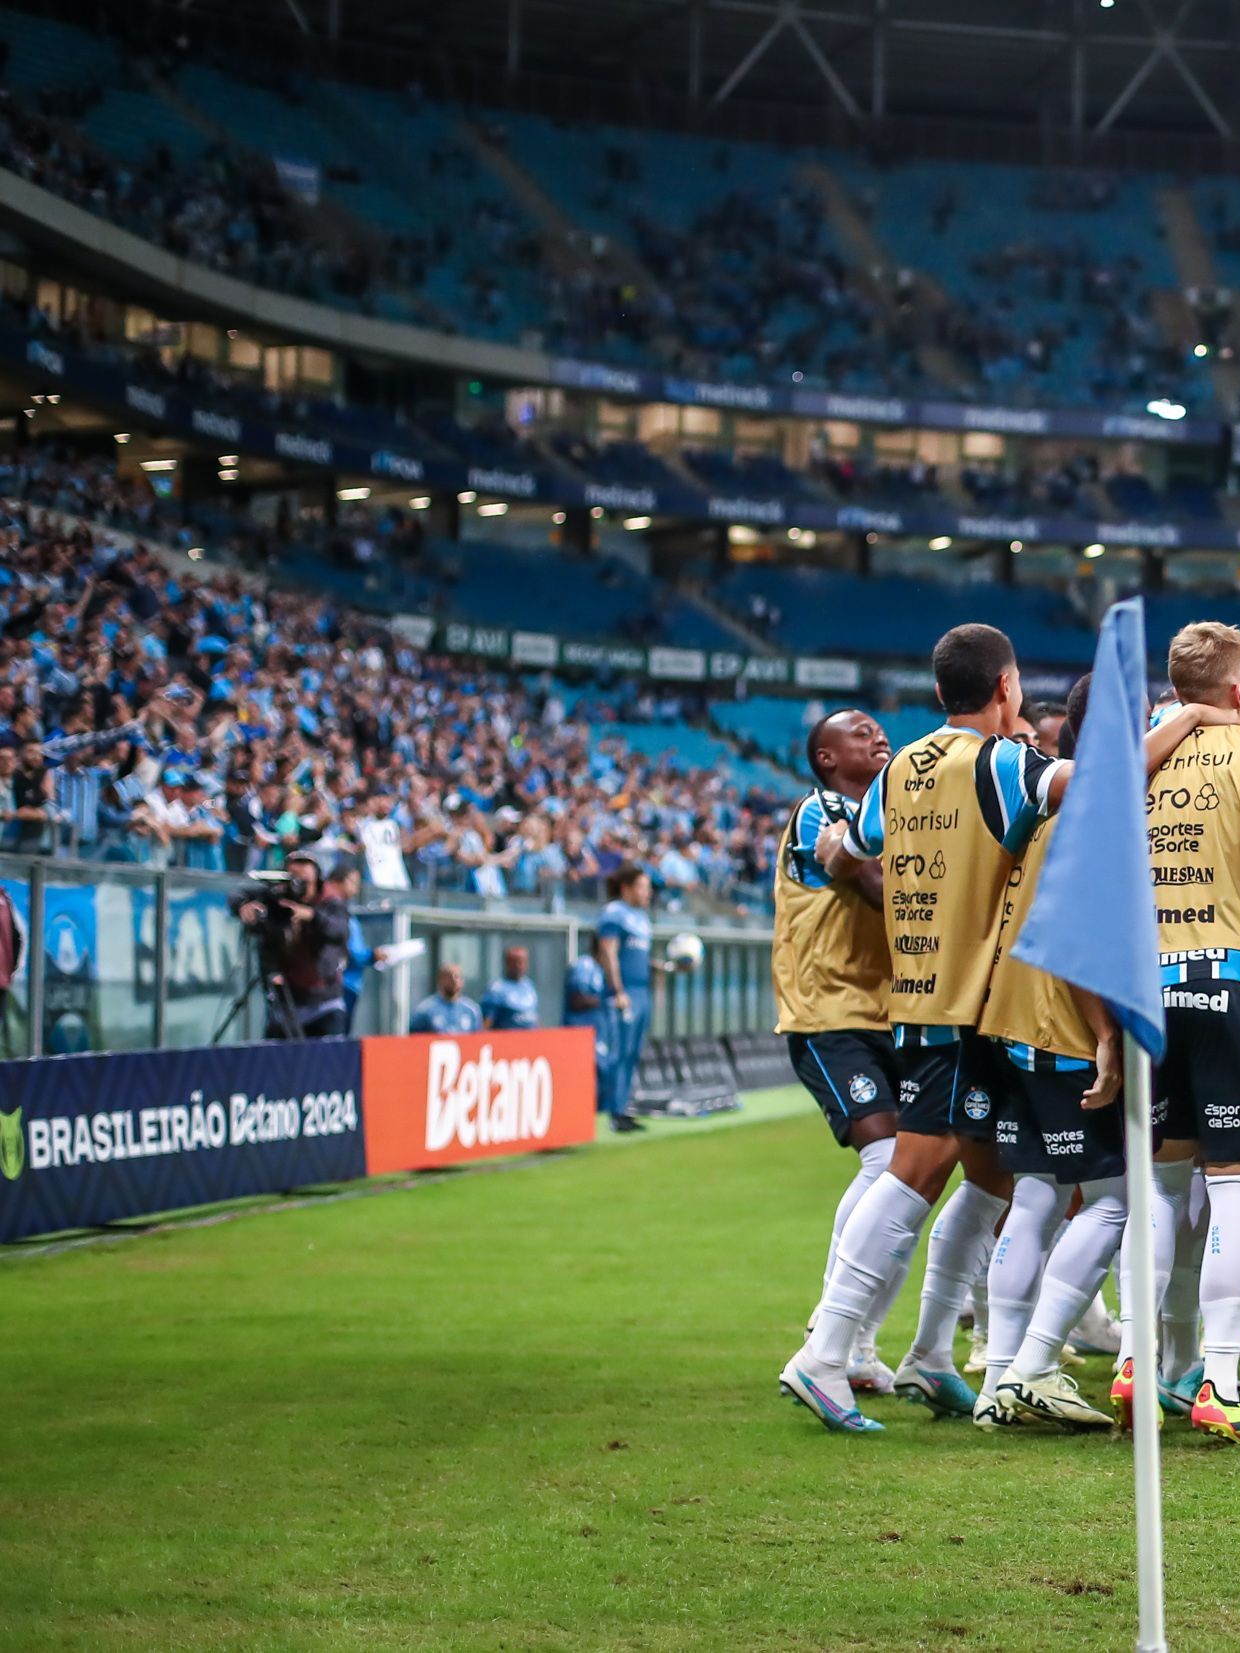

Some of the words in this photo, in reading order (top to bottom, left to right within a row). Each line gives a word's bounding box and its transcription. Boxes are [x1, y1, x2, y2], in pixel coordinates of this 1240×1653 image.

[1160, 751, 1233, 771] anrisul
[1163, 986, 1230, 1013] imed
[425, 1040, 554, 1152] Betano
[28, 1090, 226, 1169] BRASILEIRÃO
[229, 1093, 300, 1145] Betano
[302, 1089, 358, 1137] 2024
